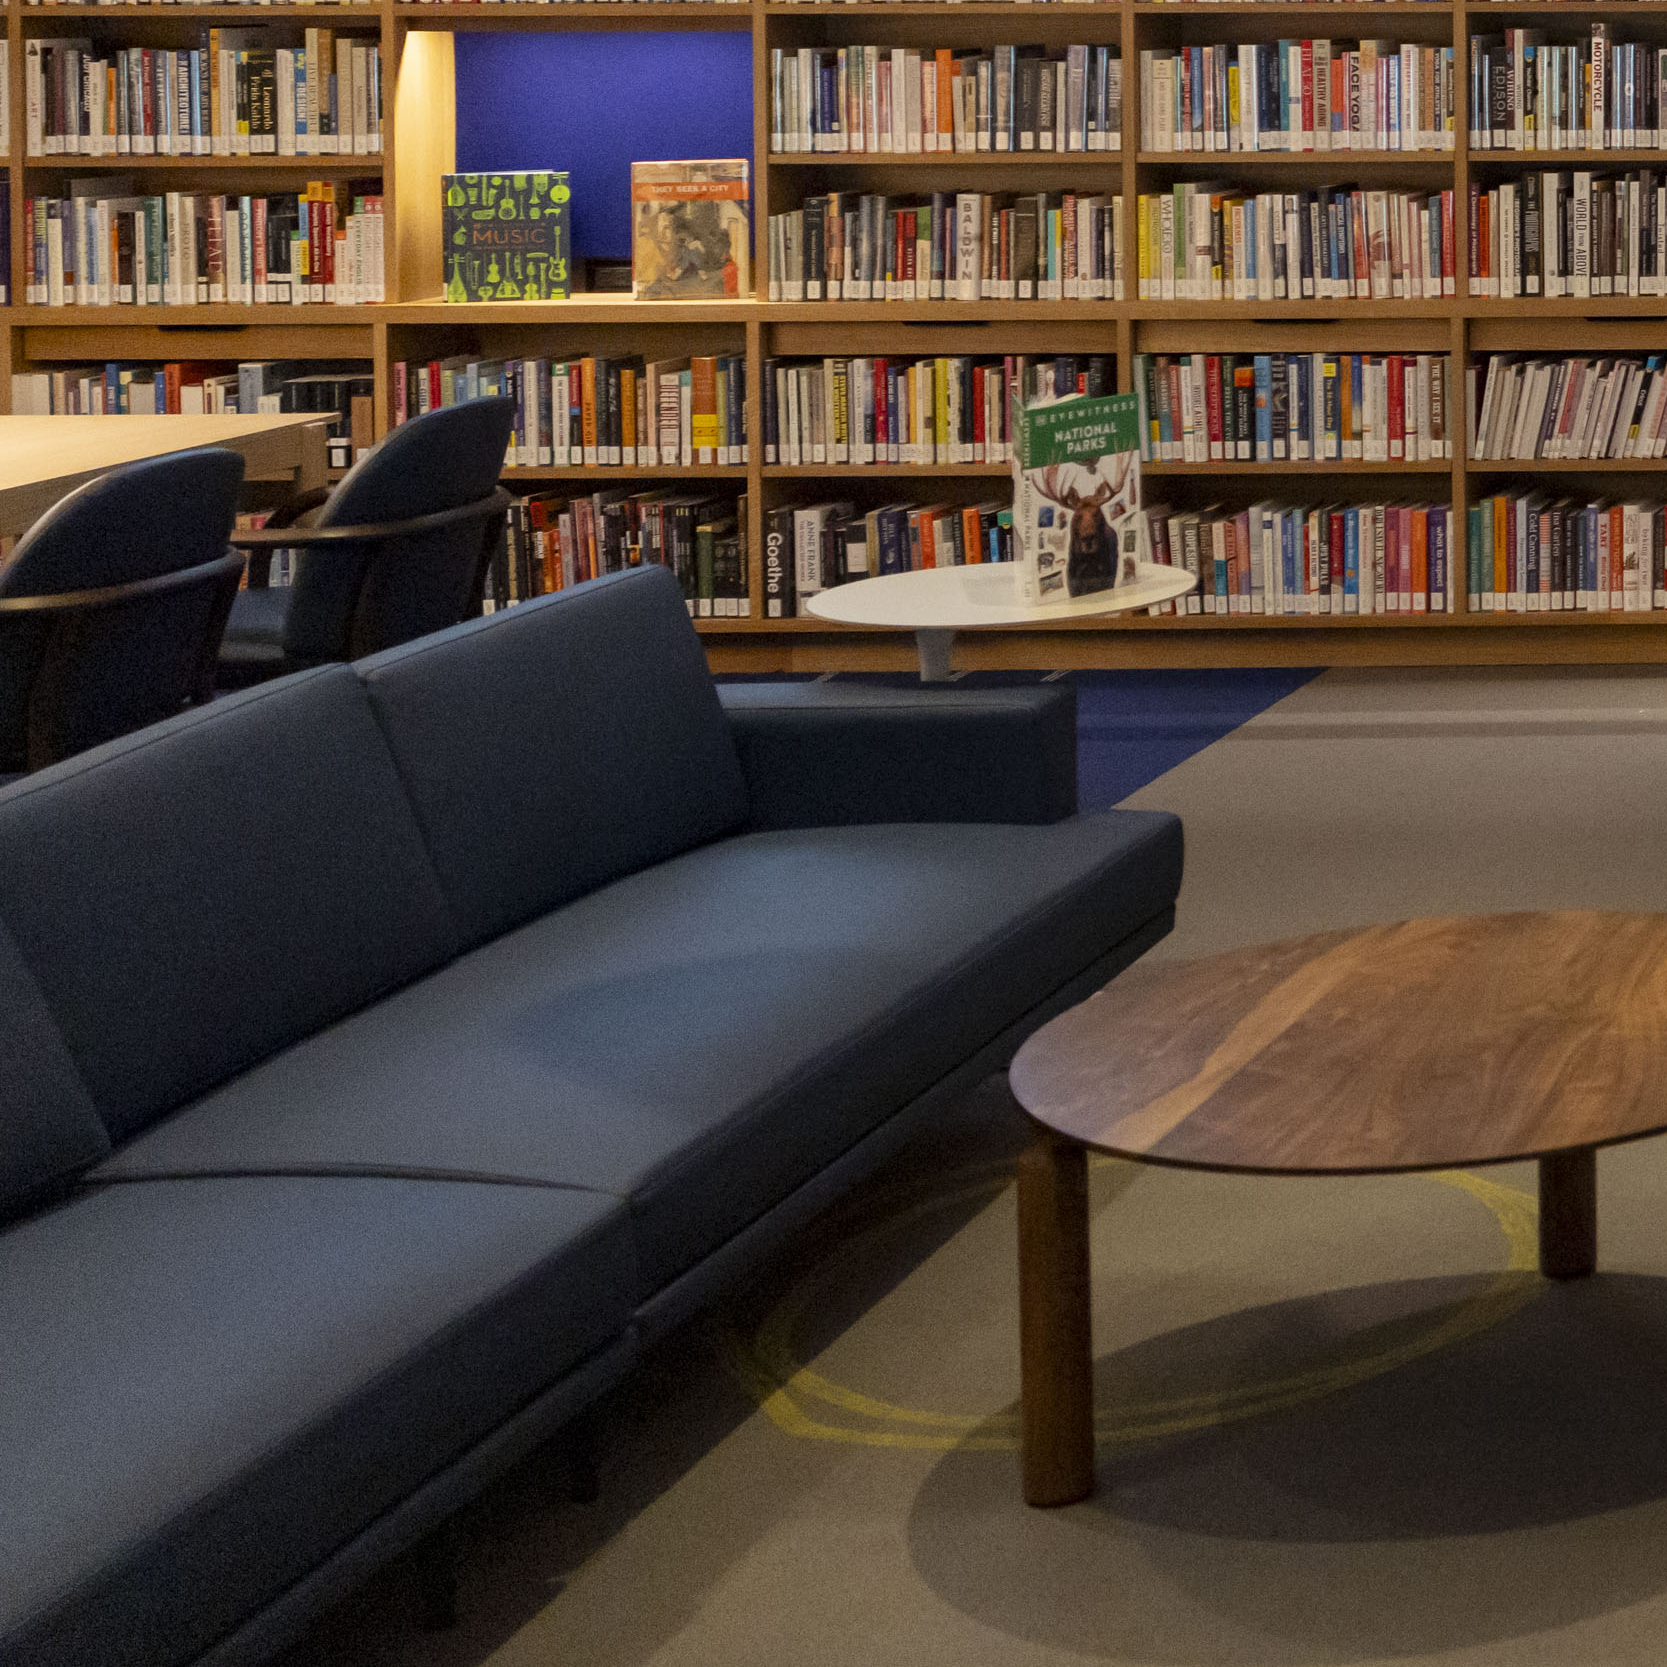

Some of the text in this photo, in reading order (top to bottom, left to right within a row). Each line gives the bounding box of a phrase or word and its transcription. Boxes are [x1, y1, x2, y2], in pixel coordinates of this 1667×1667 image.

[1351, 57, 1360, 133] FACE YOGA
[1496, 66, 1505, 121] EDISON
[1593, 42, 1602, 112] MOTORCYCLE
[250, 76, 261, 129] Frida Kahlo
[263, 87, 272, 130] Leonardo
[297, 87, 306, 118] DESIGN
[208, 218, 222, 272] ILIAD
[472, 228, 545, 245] MUSIC
[959, 203, 974, 280] BALDWIN
[1050, 401, 1135, 423] EYEWITNESS
[1055, 422, 1117, 442] NATIONAL
[1067, 437, 1106, 454] PARKS
[807, 520, 816, 581] ANNE FRANK
[1185, 530, 1197, 572] DOPESICK
[1436, 549, 1443, 558] to
[1528, 513, 1537, 570] Cold Canning
[1553, 512, 1561, 557] Ina Garten
[767, 532, 782, 593] Goethe
